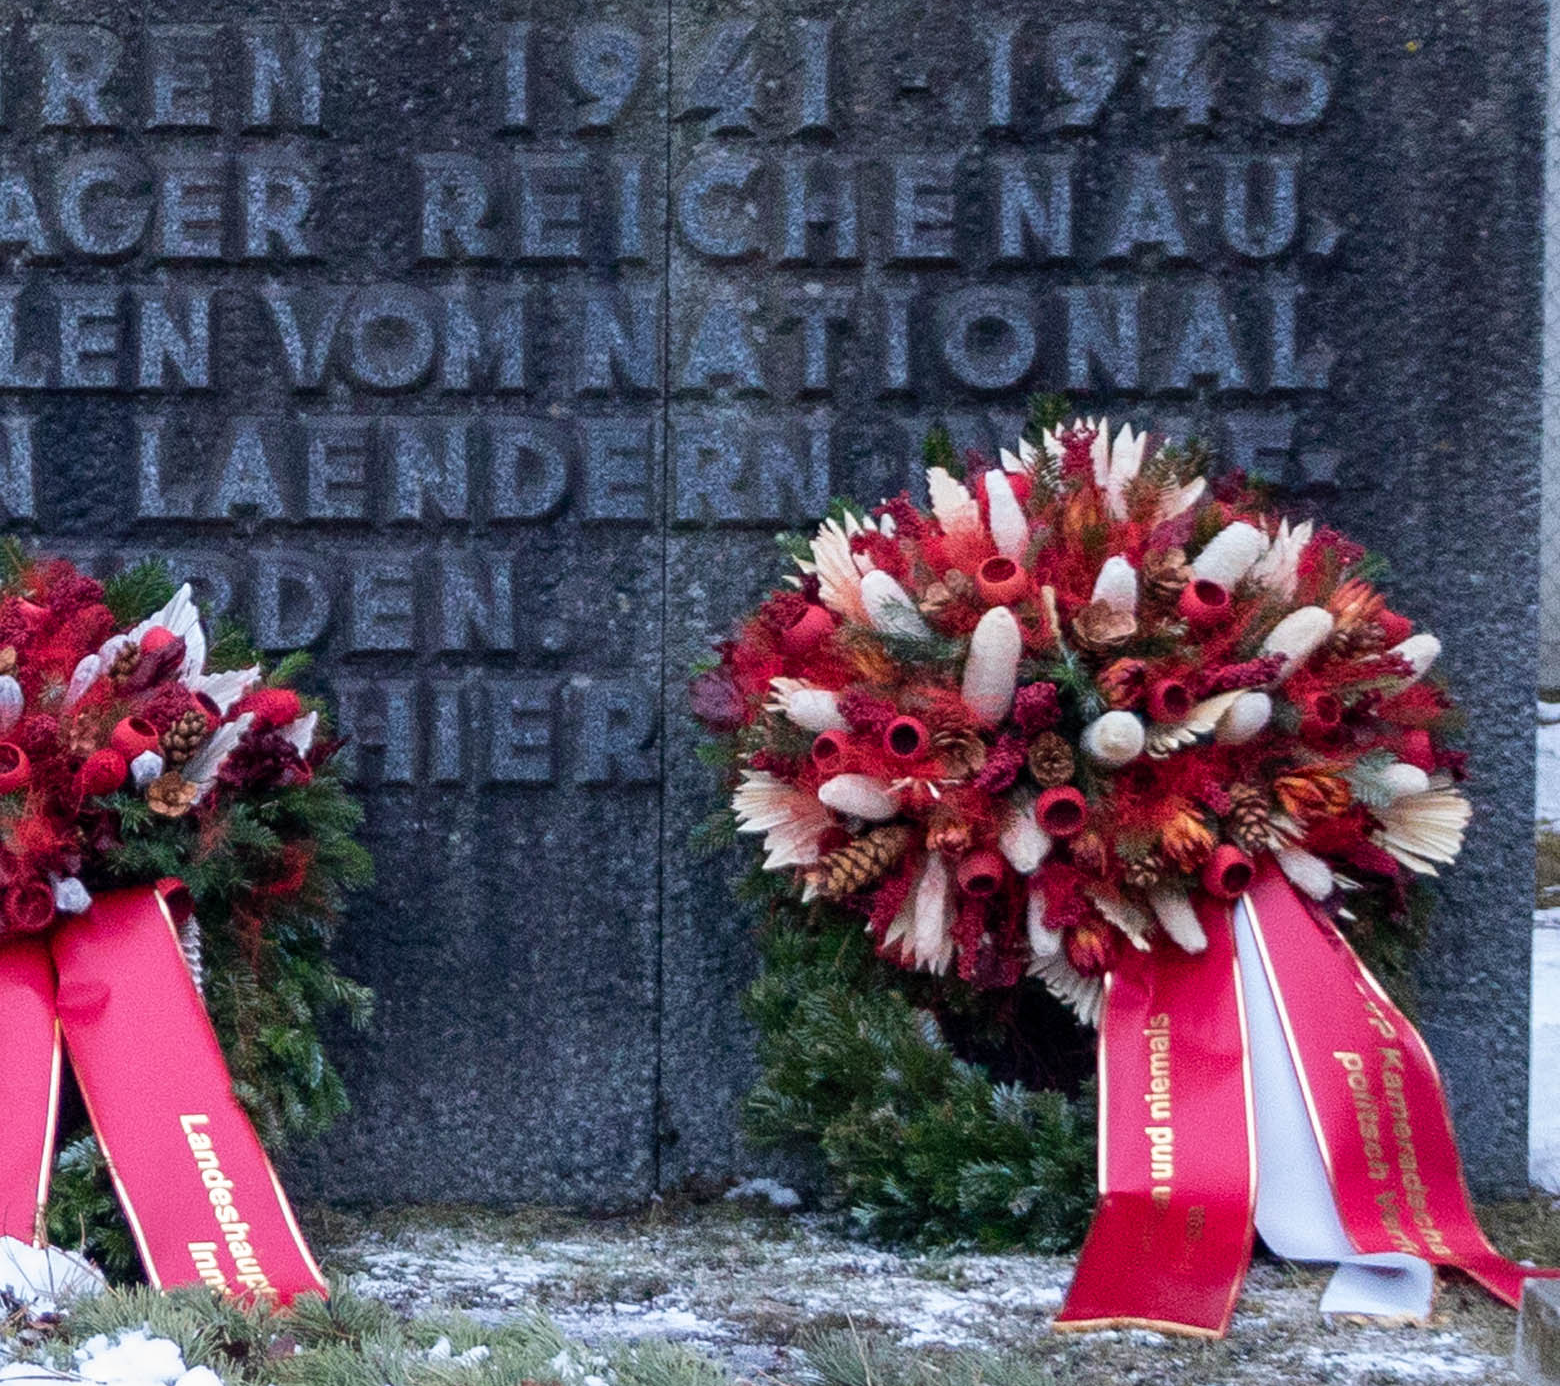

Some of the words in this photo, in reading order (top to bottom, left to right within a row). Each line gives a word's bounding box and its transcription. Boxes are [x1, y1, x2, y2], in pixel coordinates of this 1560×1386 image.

[498, 19, 831, 127] 1941
[983, 19, 1335, 127] 1945
[416, 156, 1339, 261] REICHENAU,
[264, 284, 528, 391] VOM
[581, 284, 1333, 392] NATIONAL
[137, 418, 830, 521] LAENDERN
[335, 674, 660, 783] HIER
[1143, 1013, 1172, 1121] niemals
[1144, 1125, 1174, 1182] und
